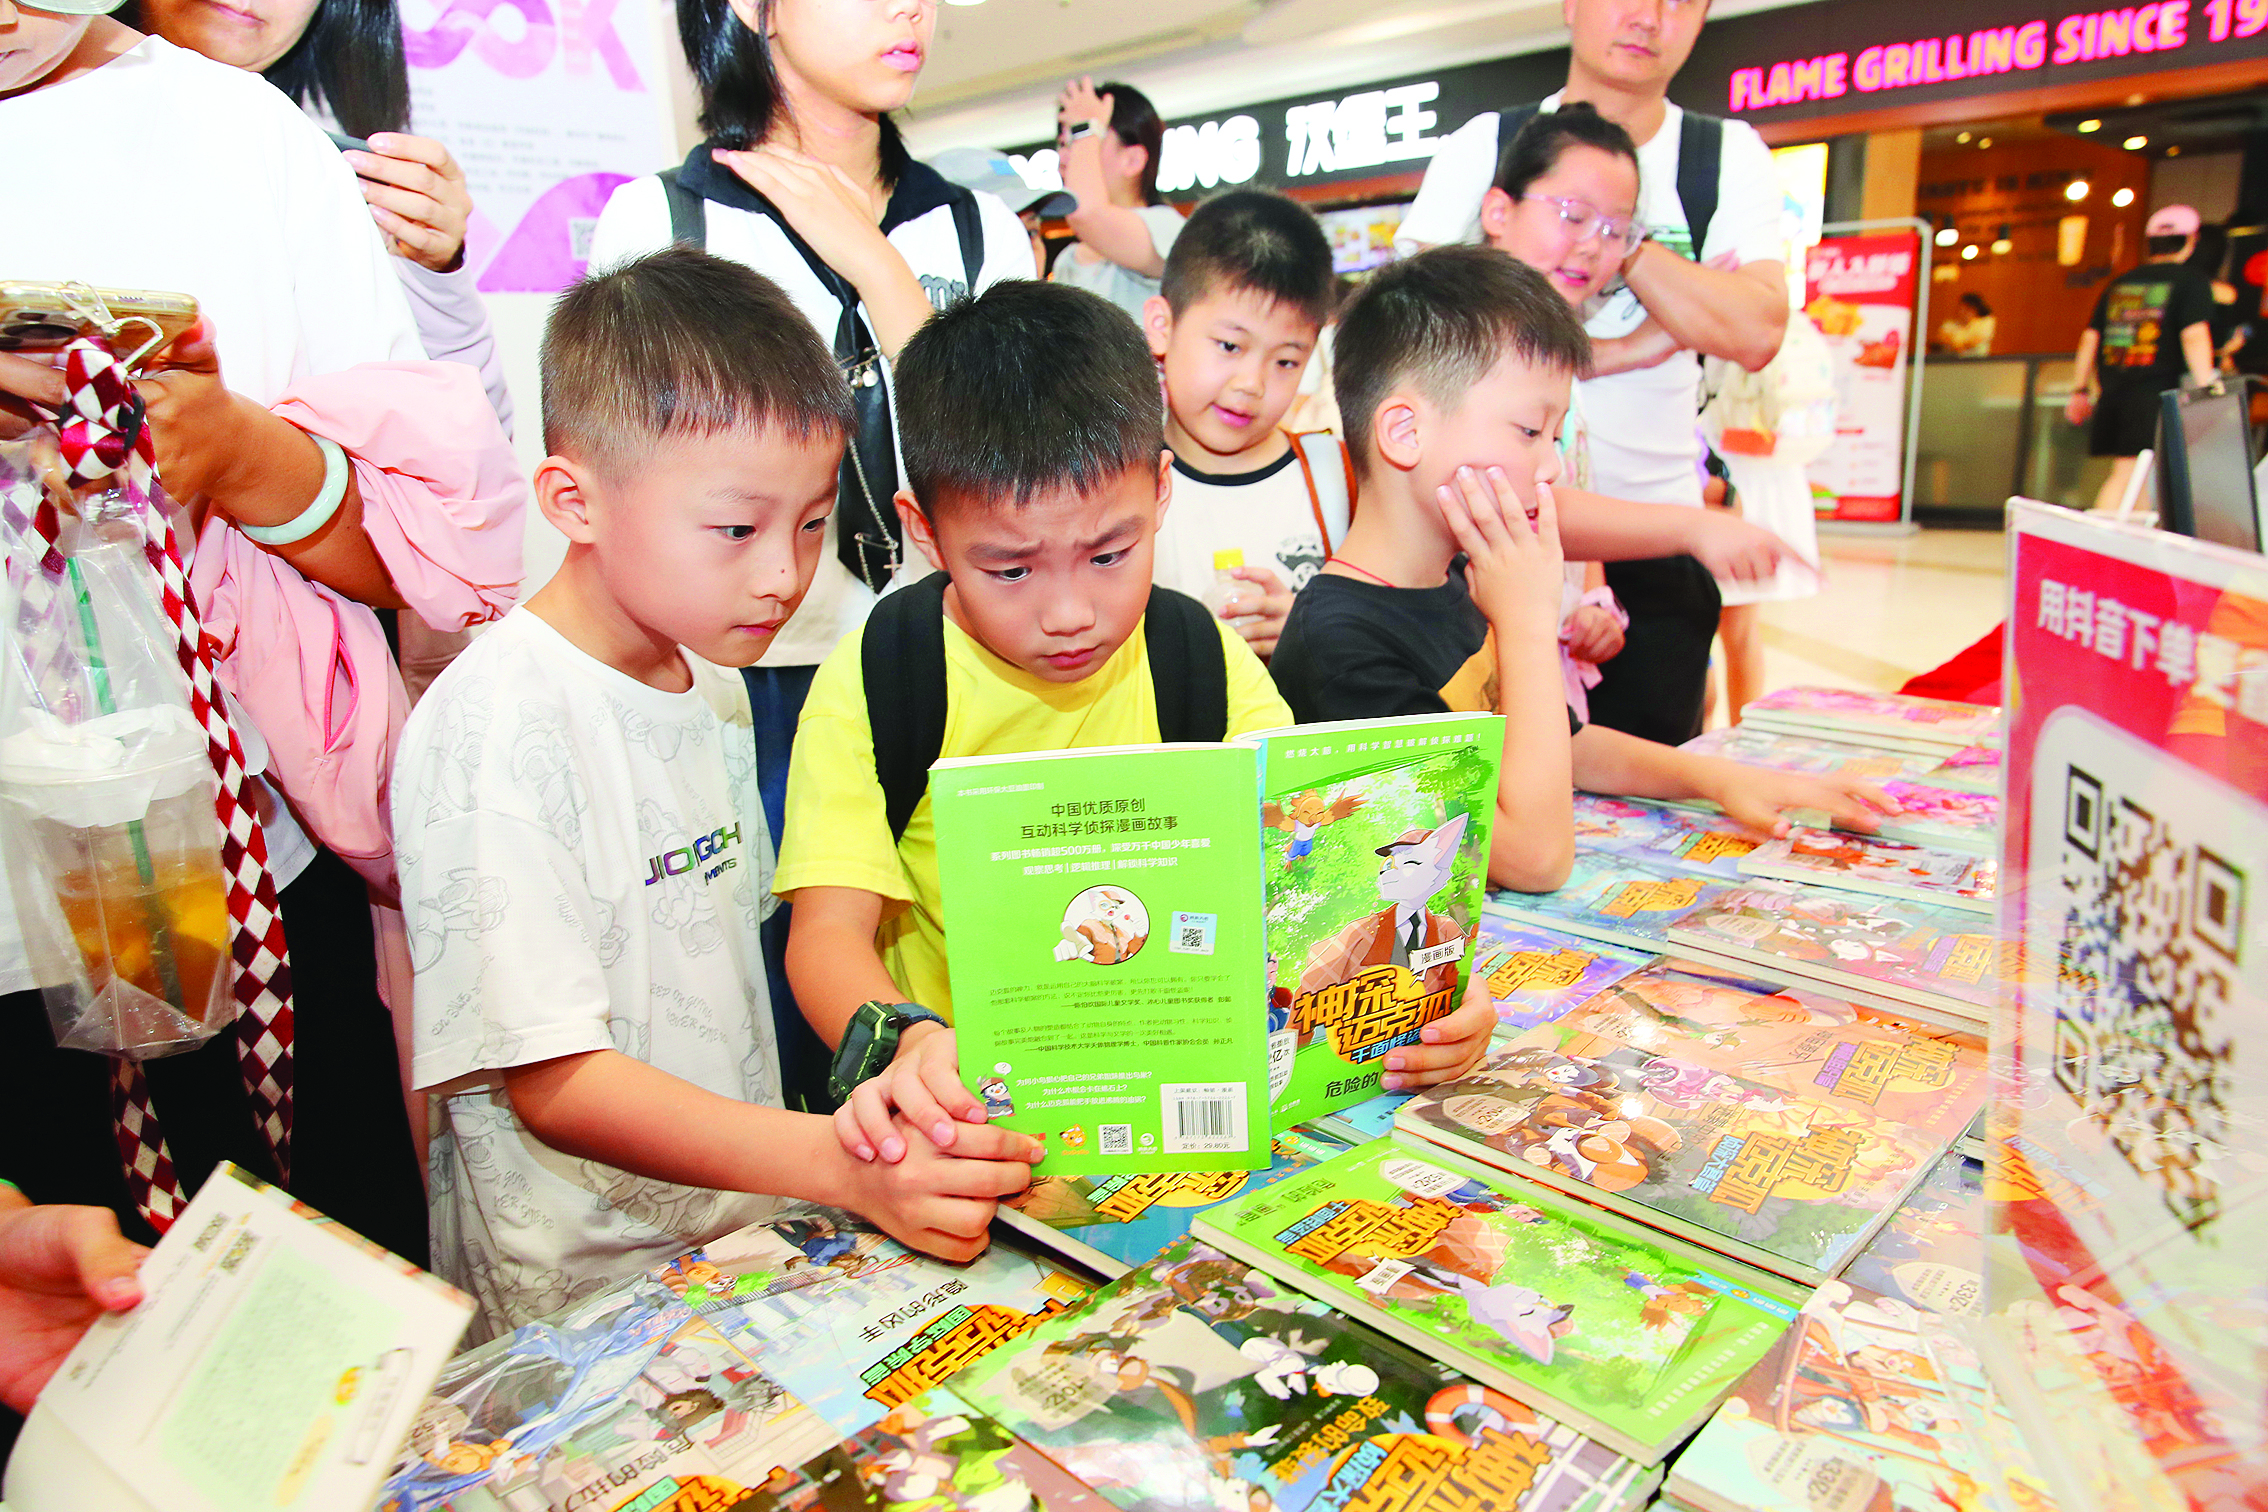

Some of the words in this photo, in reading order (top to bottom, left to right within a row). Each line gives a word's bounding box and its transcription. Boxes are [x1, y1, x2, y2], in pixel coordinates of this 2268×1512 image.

[1729, 52, 1848, 111] FLAME
[1854, 20, 2046, 92] GRILLING
[2053, 0, 2190, 65] SINCE
[1156, 114, 1260, 192] ING
[1286, 81, 1440, 177] 汉堡王
[1021, 816, 1178, 839] 互动科学侦探漫画故事
[1051, 798, 1146, 817] 中国优质原创
[1421, 945, 1455, 963] 漫画版
[1294, 967, 1397, 1035] 神探
[1338, 986, 1456, 1055] 迈克狐
[1830, 1041, 1905, 1106] 迈克狐
[1690, 1134, 1746, 1195] 侦探大赛篇
[1709, 1131, 1805, 1216] 迈克狐
[1778, 1124, 1866, 1193] 神探
[1273, 1200, 1351, 1246] 千面怪盗篇
[1283, 1200, 1399, 1267] 迈克狐
[1360, 1197, 1464, 1255] 神探
[858, 1277, 969, 1343] 隐形的凶手
[860, 1304, 973, 1387] 国际学院篇
[863, 1305, 1013, 1412] 迈克狐
[1272, 1395, 1391, 1485] 致命的裂缝
